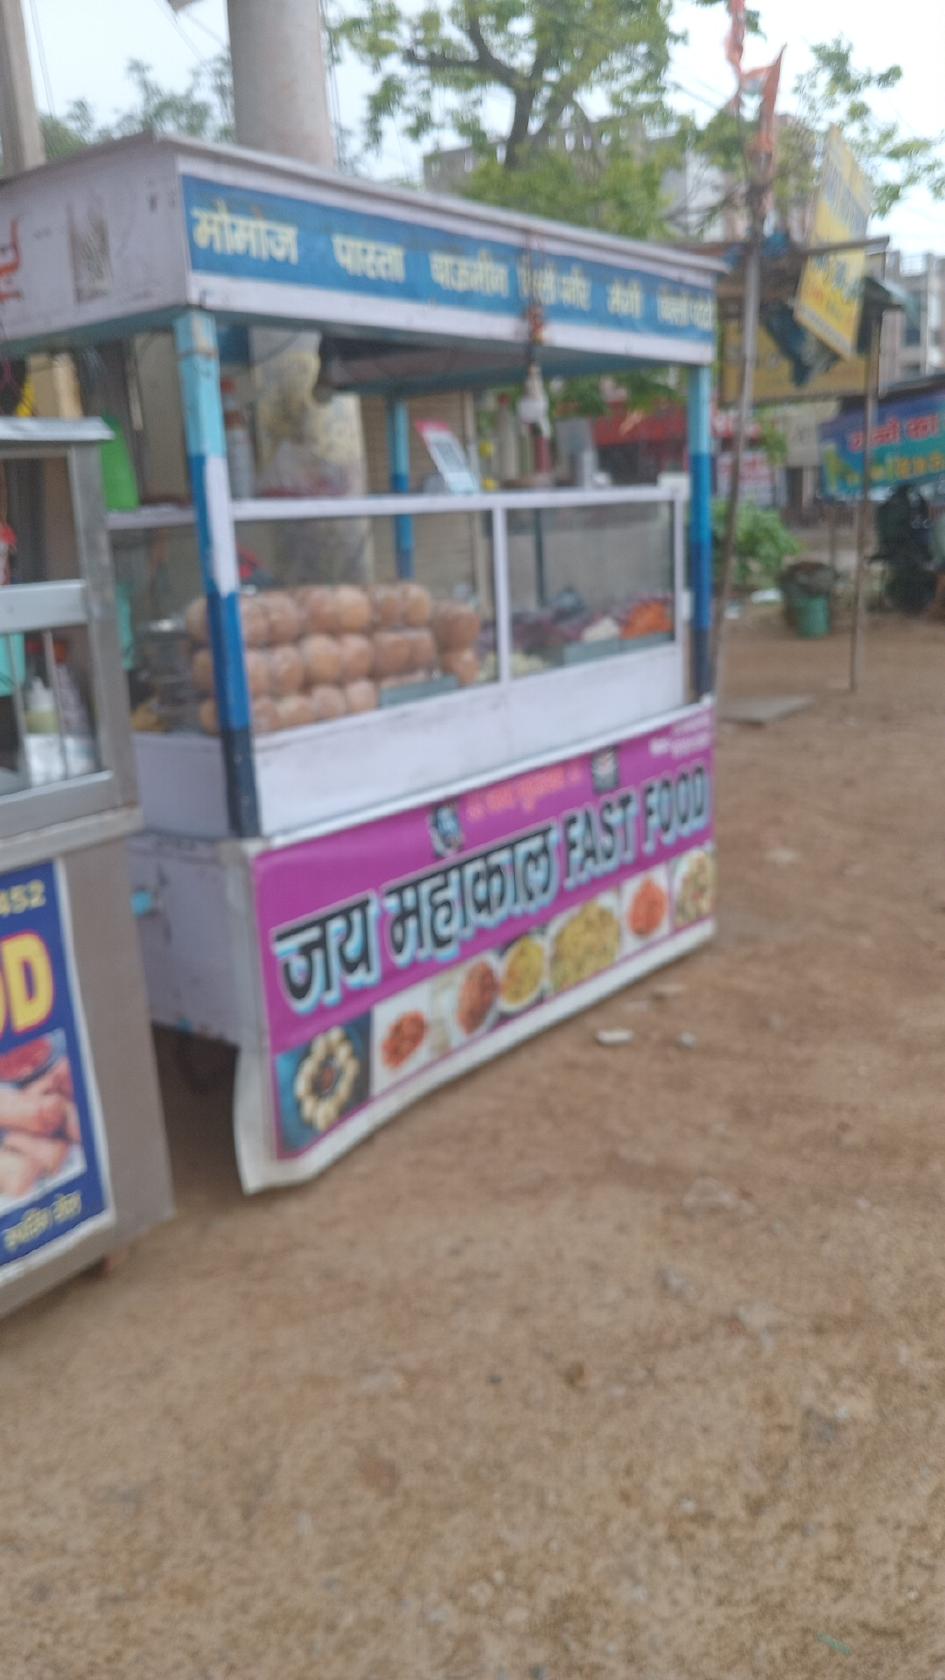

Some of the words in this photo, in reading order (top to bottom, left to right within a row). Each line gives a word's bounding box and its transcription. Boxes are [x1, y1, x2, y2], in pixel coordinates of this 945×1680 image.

[271, 891, 381, 1015] जय
[382, 818, 560, 969] महाकाल
[562, 786, 638, 892] FAST
[640, 760, 713, 855] FOOD
[0, 929, 54, 1038] D
